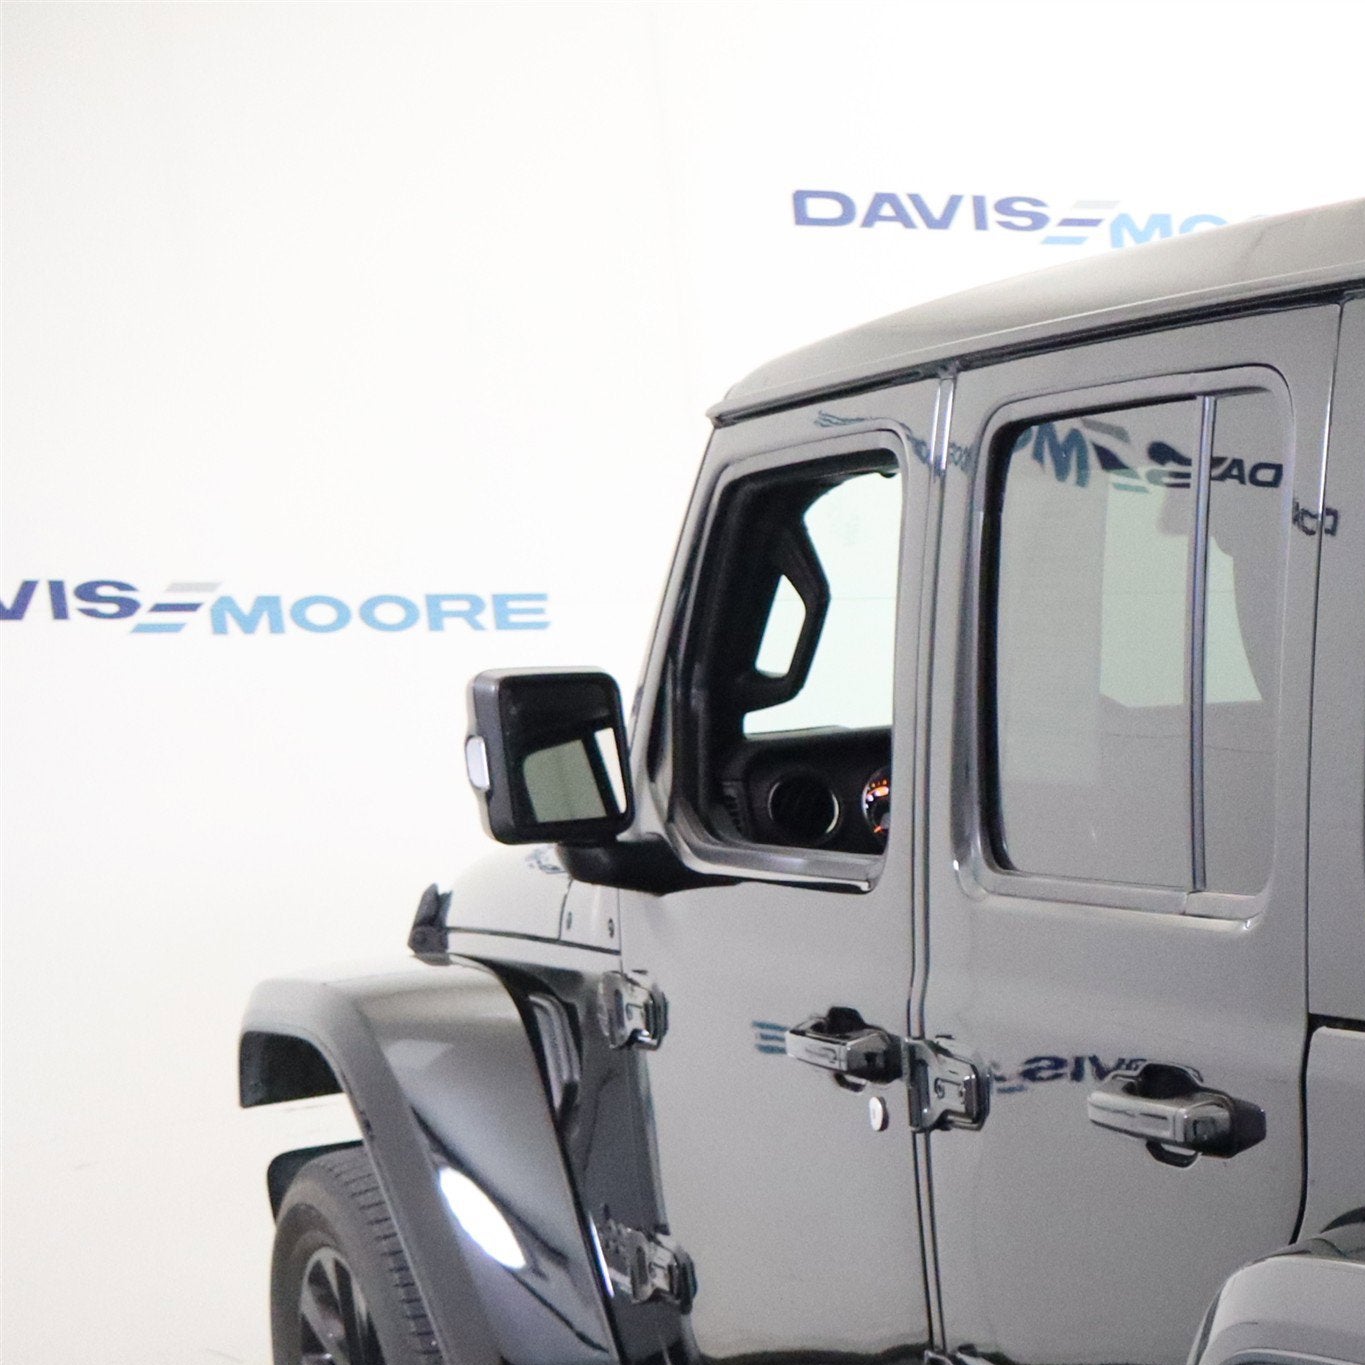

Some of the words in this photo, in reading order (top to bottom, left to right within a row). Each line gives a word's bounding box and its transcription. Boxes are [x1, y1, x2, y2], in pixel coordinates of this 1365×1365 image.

[793, 189, 1050, 231] DAVIS
[0, 579, 141, 621] VIS
[211, 593, 550, 634] MOORE
